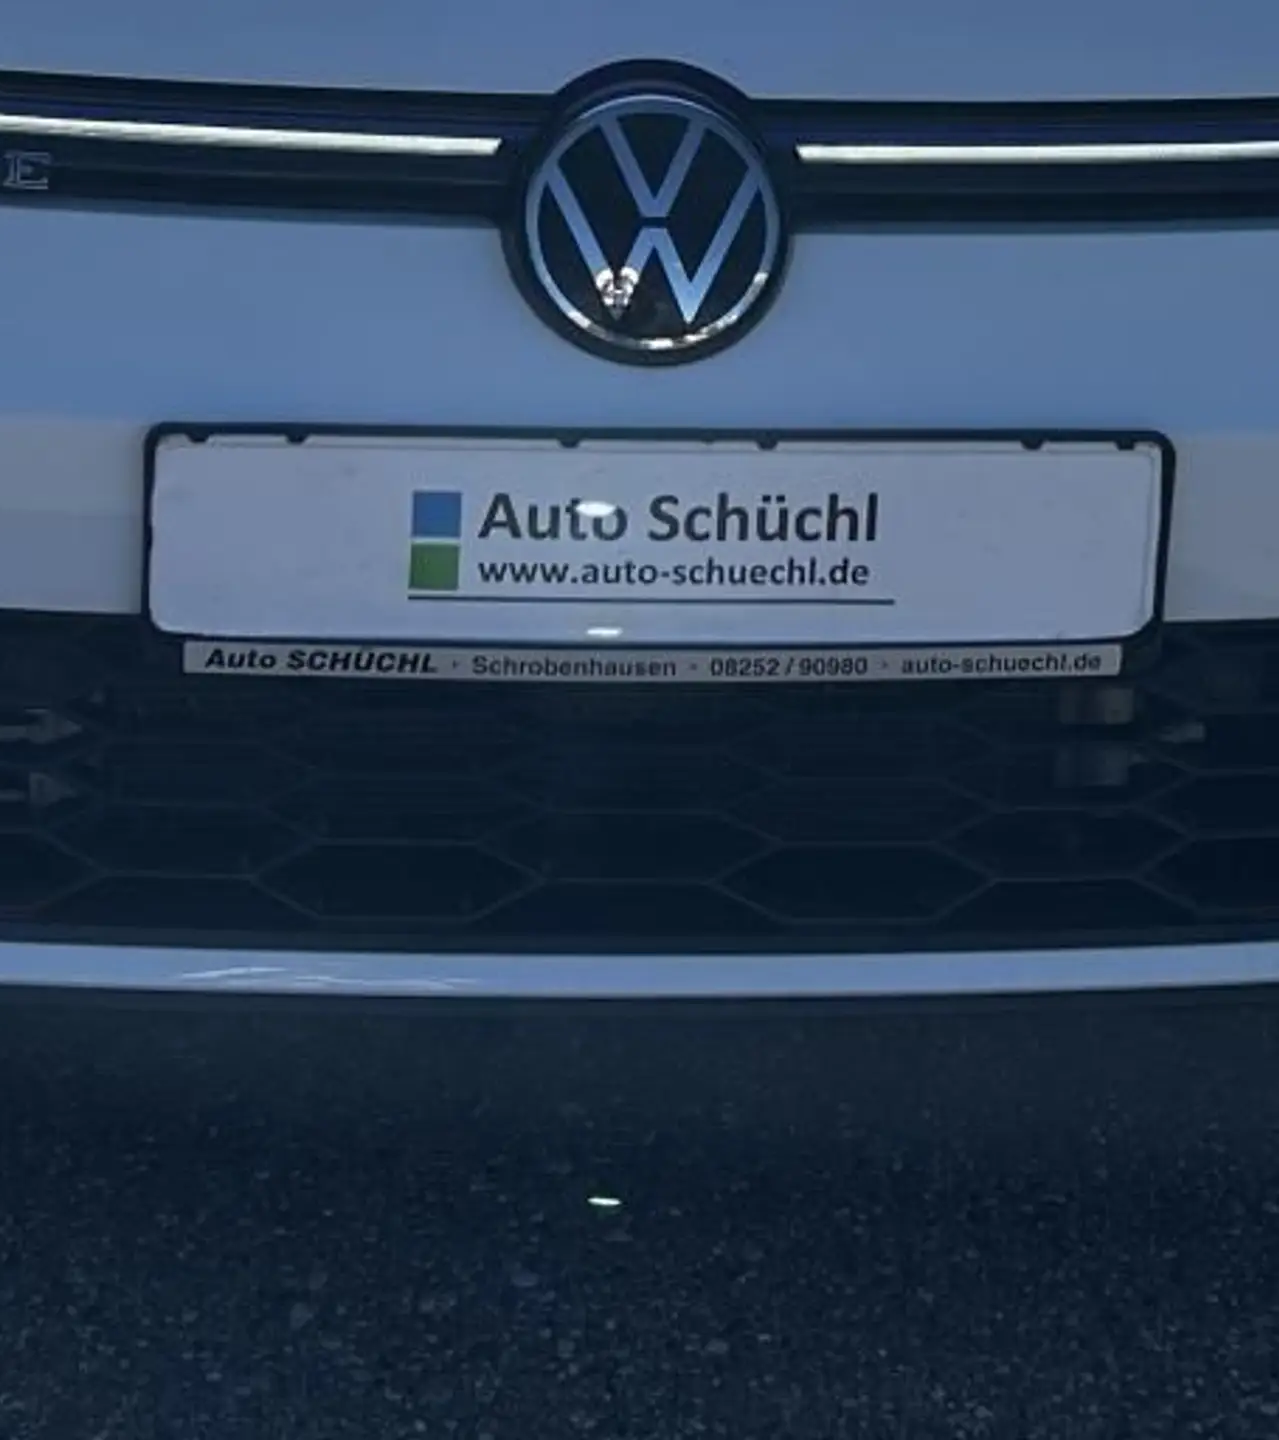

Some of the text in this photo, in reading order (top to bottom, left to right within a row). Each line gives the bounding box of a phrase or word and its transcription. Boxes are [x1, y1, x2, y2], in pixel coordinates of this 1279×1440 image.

[477, 492, 878, 543] Auto Schüchl
[477, 556, 870, 586] www.auto-schuechl.de
[204, 647, 277, 671] Auto
[286, 644, 439, 674] SCHÜCHL
[471, 655, 677, 678] Schrobenhausen
[900, 650, 1102, 675] auto-schuechl.de
